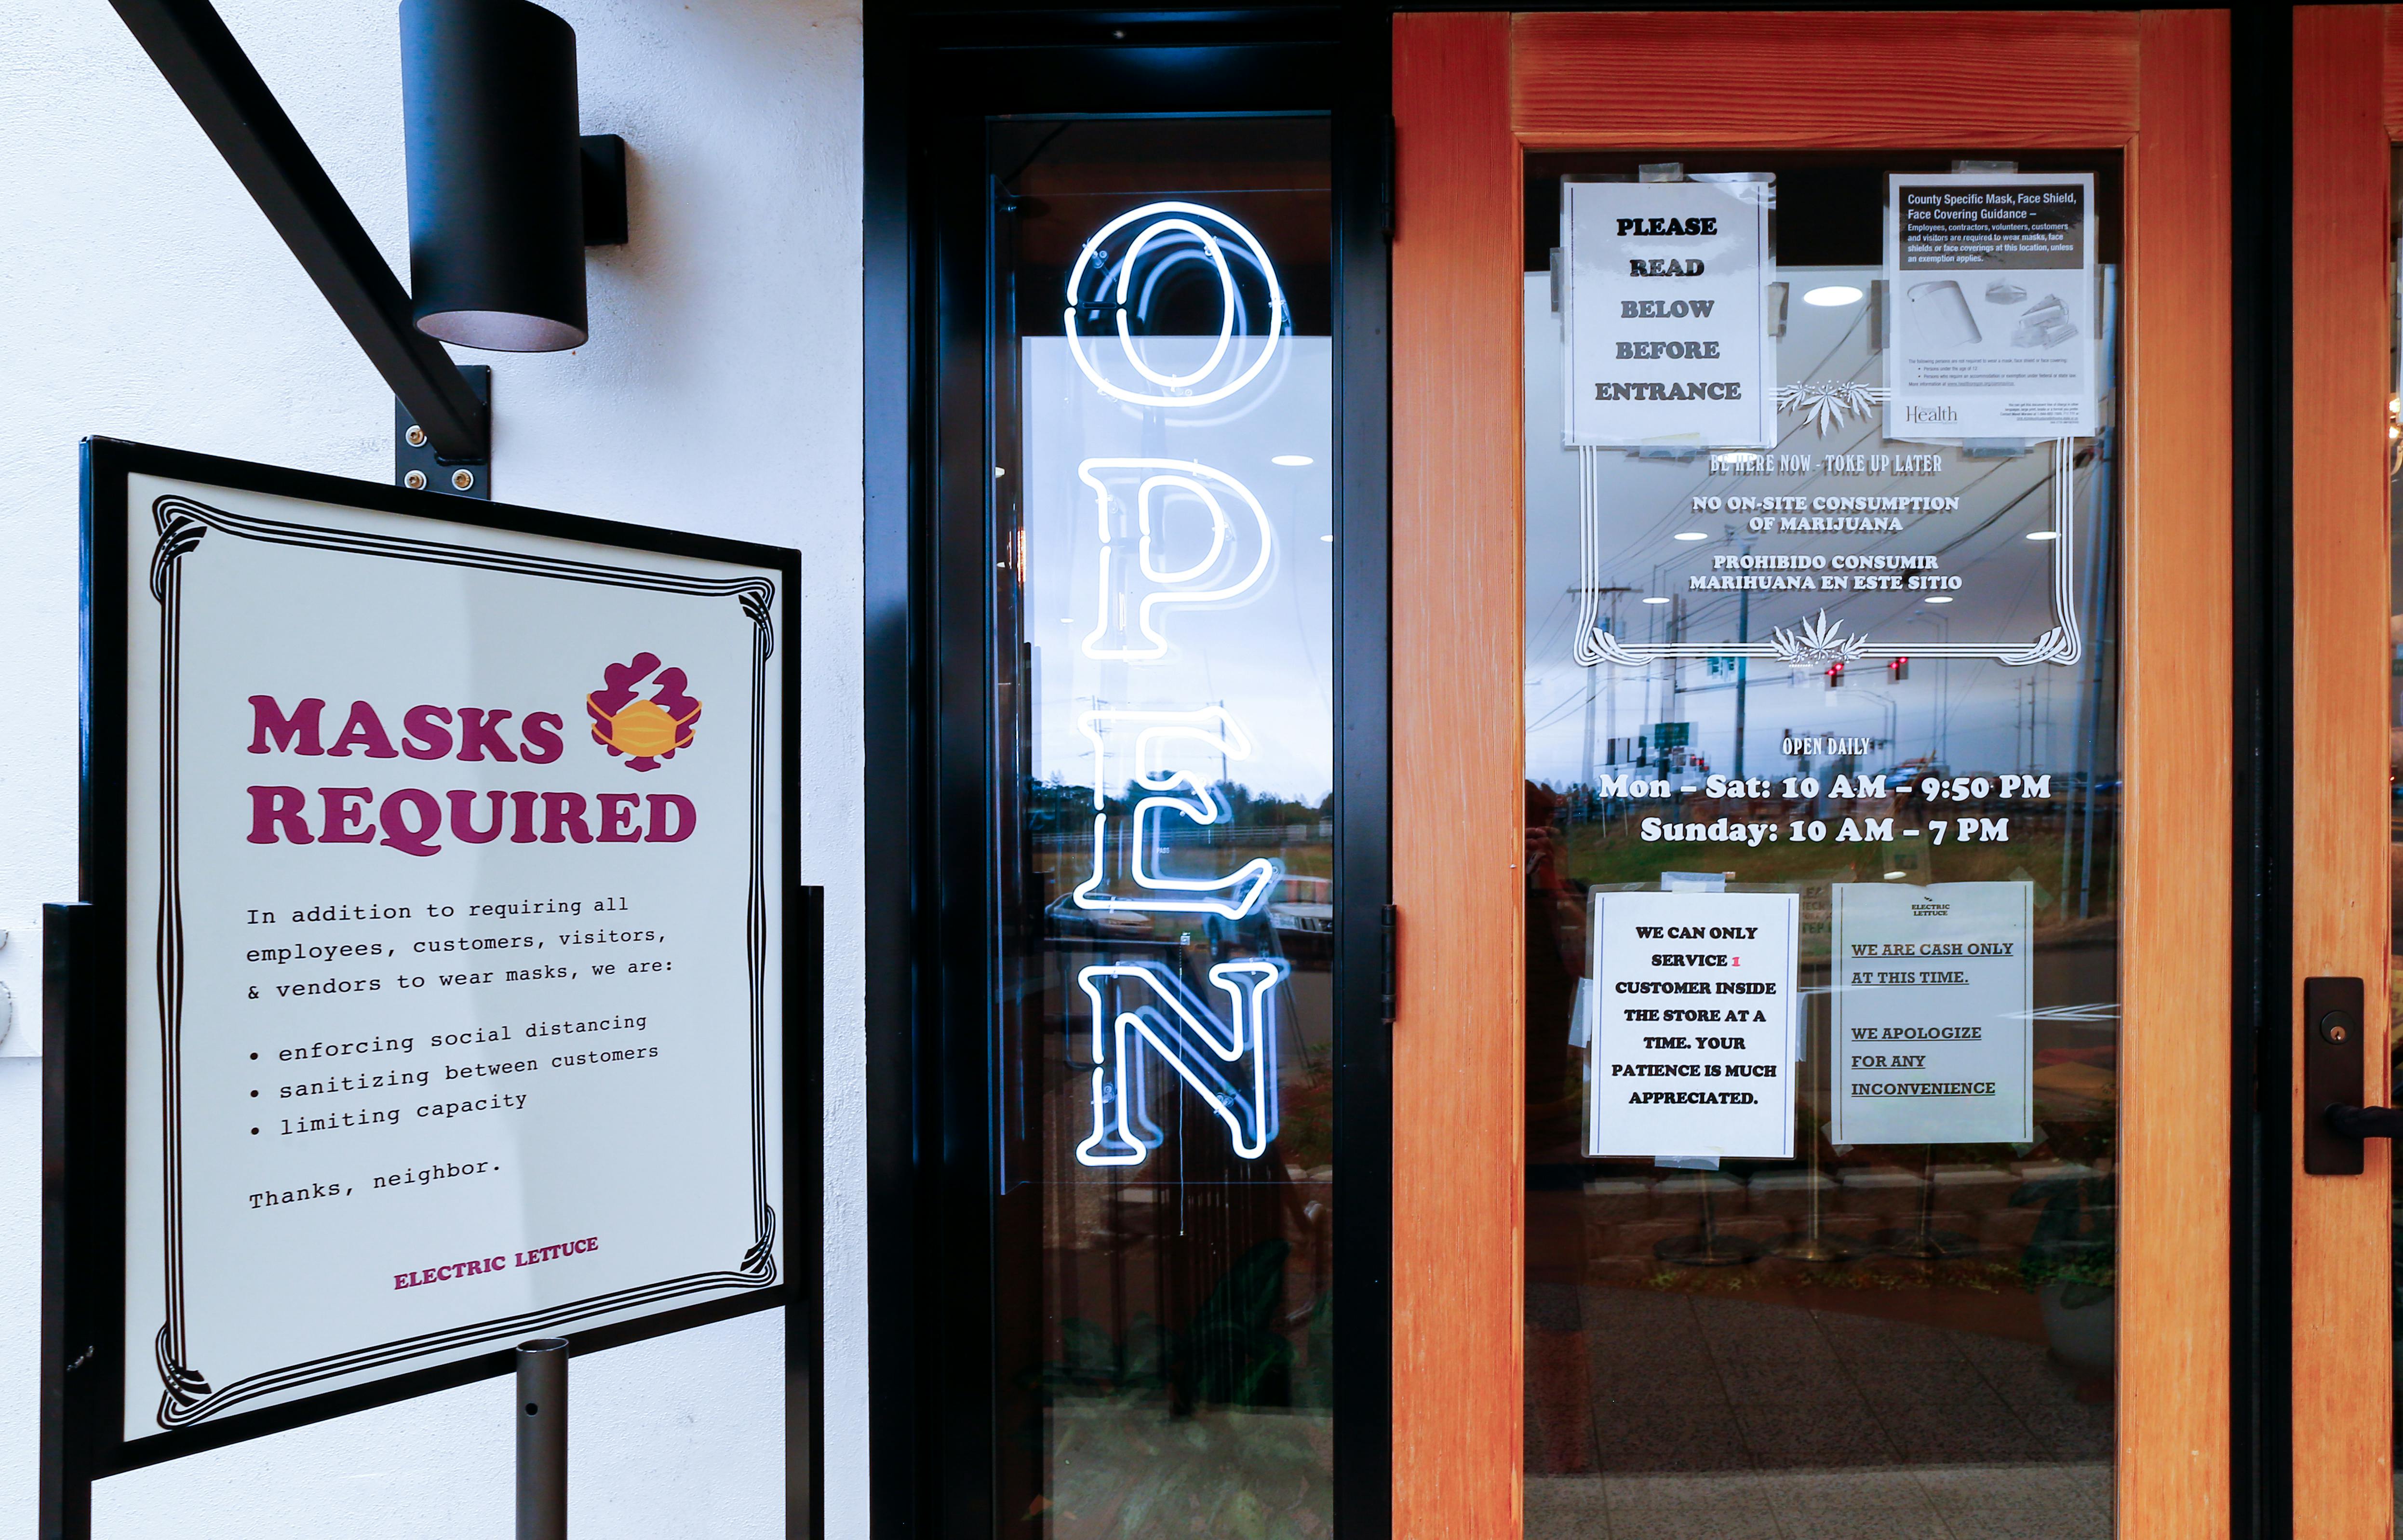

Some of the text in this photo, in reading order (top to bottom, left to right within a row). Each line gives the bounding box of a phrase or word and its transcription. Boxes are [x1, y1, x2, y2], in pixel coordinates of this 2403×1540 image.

[1908, 193, 2076, 206] County Specific Mask, Face Shield,
[1908, 209, 1931, 219] Face
[1934, 209, 1977, 221] Covering
[1981, 209, 2027, 219] Guidance
[1616, 217, 1718, 236] PLEASE
[1908, 224, 1947, 232] Employees,
[1948, 223, 1990, 231] contractors,
[1949, 234, 1962, 242] are
[1963, 234, 1993, 243] required
[2022, 233, 2048, 242] masks,
[1907, 244, 1933, 252] shields
[1960, 243, 1994, 253] coverings
[2019, 243, 2049, 252] location,
[1918, 254, 1955, 263] exemption
[1956, 254, 1984, 263] applies.
[1629, 258, 1705, 277] READ
[1621, 300, 1715, 319] BELOW
[1615, 341, 1720, 360] BEFORE
[1595, 382, 1742, 401] ENTRANCE
[1906, 405, 1957, 424] Health
[1710, 454, 1730, 472] BE
[1735, 454, 1775, 472] HERE
[1780, 454, 1812, 472] NOW
[1825, 454, 1865, 472] TOKE
[1870, 454, 1890, 472] UP
[1895, 454, 1943, 472] LATER
[1692, 496, 1960, 511] NO ON-SITE CONSUMPTION
[1748, 517, 1904, 531] OF MARIJUANA
[1713, 555, 1939, 570] PROHIBIDO CONSUMIR
[1689, 576, 1962, 589] MARIHUANA EN ESTE SITIO
[1063, 201, 1282, 1166] OPEN
[247, 695, 564, 764] MASKS
[1783, 737, 1870, 755] OPEN DAILY
[1598, 774, 1671, 798] Mon
[1706, 773, 1770, 798] Sat:
[1782, 777, 1820, 798] 10
[1828, 774, 1887, 798] AM
[1921, 777, 1989, 802] 9:50
[1999, 775, 2051, 798] PM
[246, 785, 697, 857] REQUIRED
[1641, 817, 1778, 847] Sunday:
[1789, 820, 1826, 842] 10
[1835, 817, 1894, 842] AM
[1929, 820, 1947, 845] 7
[1957, 818, 2009, 842] PM
[247, 897, 628, 924] In addition to requiring all
[1636, 926, 1758, 939] WE CAN ONLY
[247, 929, 664, 964] employees, customers, visitors,
[1851, 943, 2014, 956] WE ARE CASH ONLY
[1651, 954, 1740, 967] SERVICE 1
[248, 962, 671, 999] & vendors to wear masks, we are:
[1851, 971, 1968, 984] AT THIS TIME.
[1615, 981, 1776, 995] CUSTOMER INSIDE
[1624, 1009, 1767, 1022] THE STORE AT A
[279, 1015, 646, 1061] enforcing social distancing
[1851, 1027, 1982, 1040] WE APOLOGIZE
[1643, 1037, 1746, 1050] TIME. YOUR
[1852, 1055, 1926, 1067] FOR ANY
[281, 1047, 658, 1098] sanitizing between customers
[1611, 1064, 1777, 1077] PATIENCE IS MUCH
[1851, 1082, 1996, 1096] INCONVENIENCE
[1628, 1091, 1759, 1105] APPRECIATED.
[281, 1094, 526, 1135] limiting capacity
[249, 1162, 499, 1209] Thanks, neighbor.
[394, 1237, 598, 1290] ELECTRIC LETTUCE
